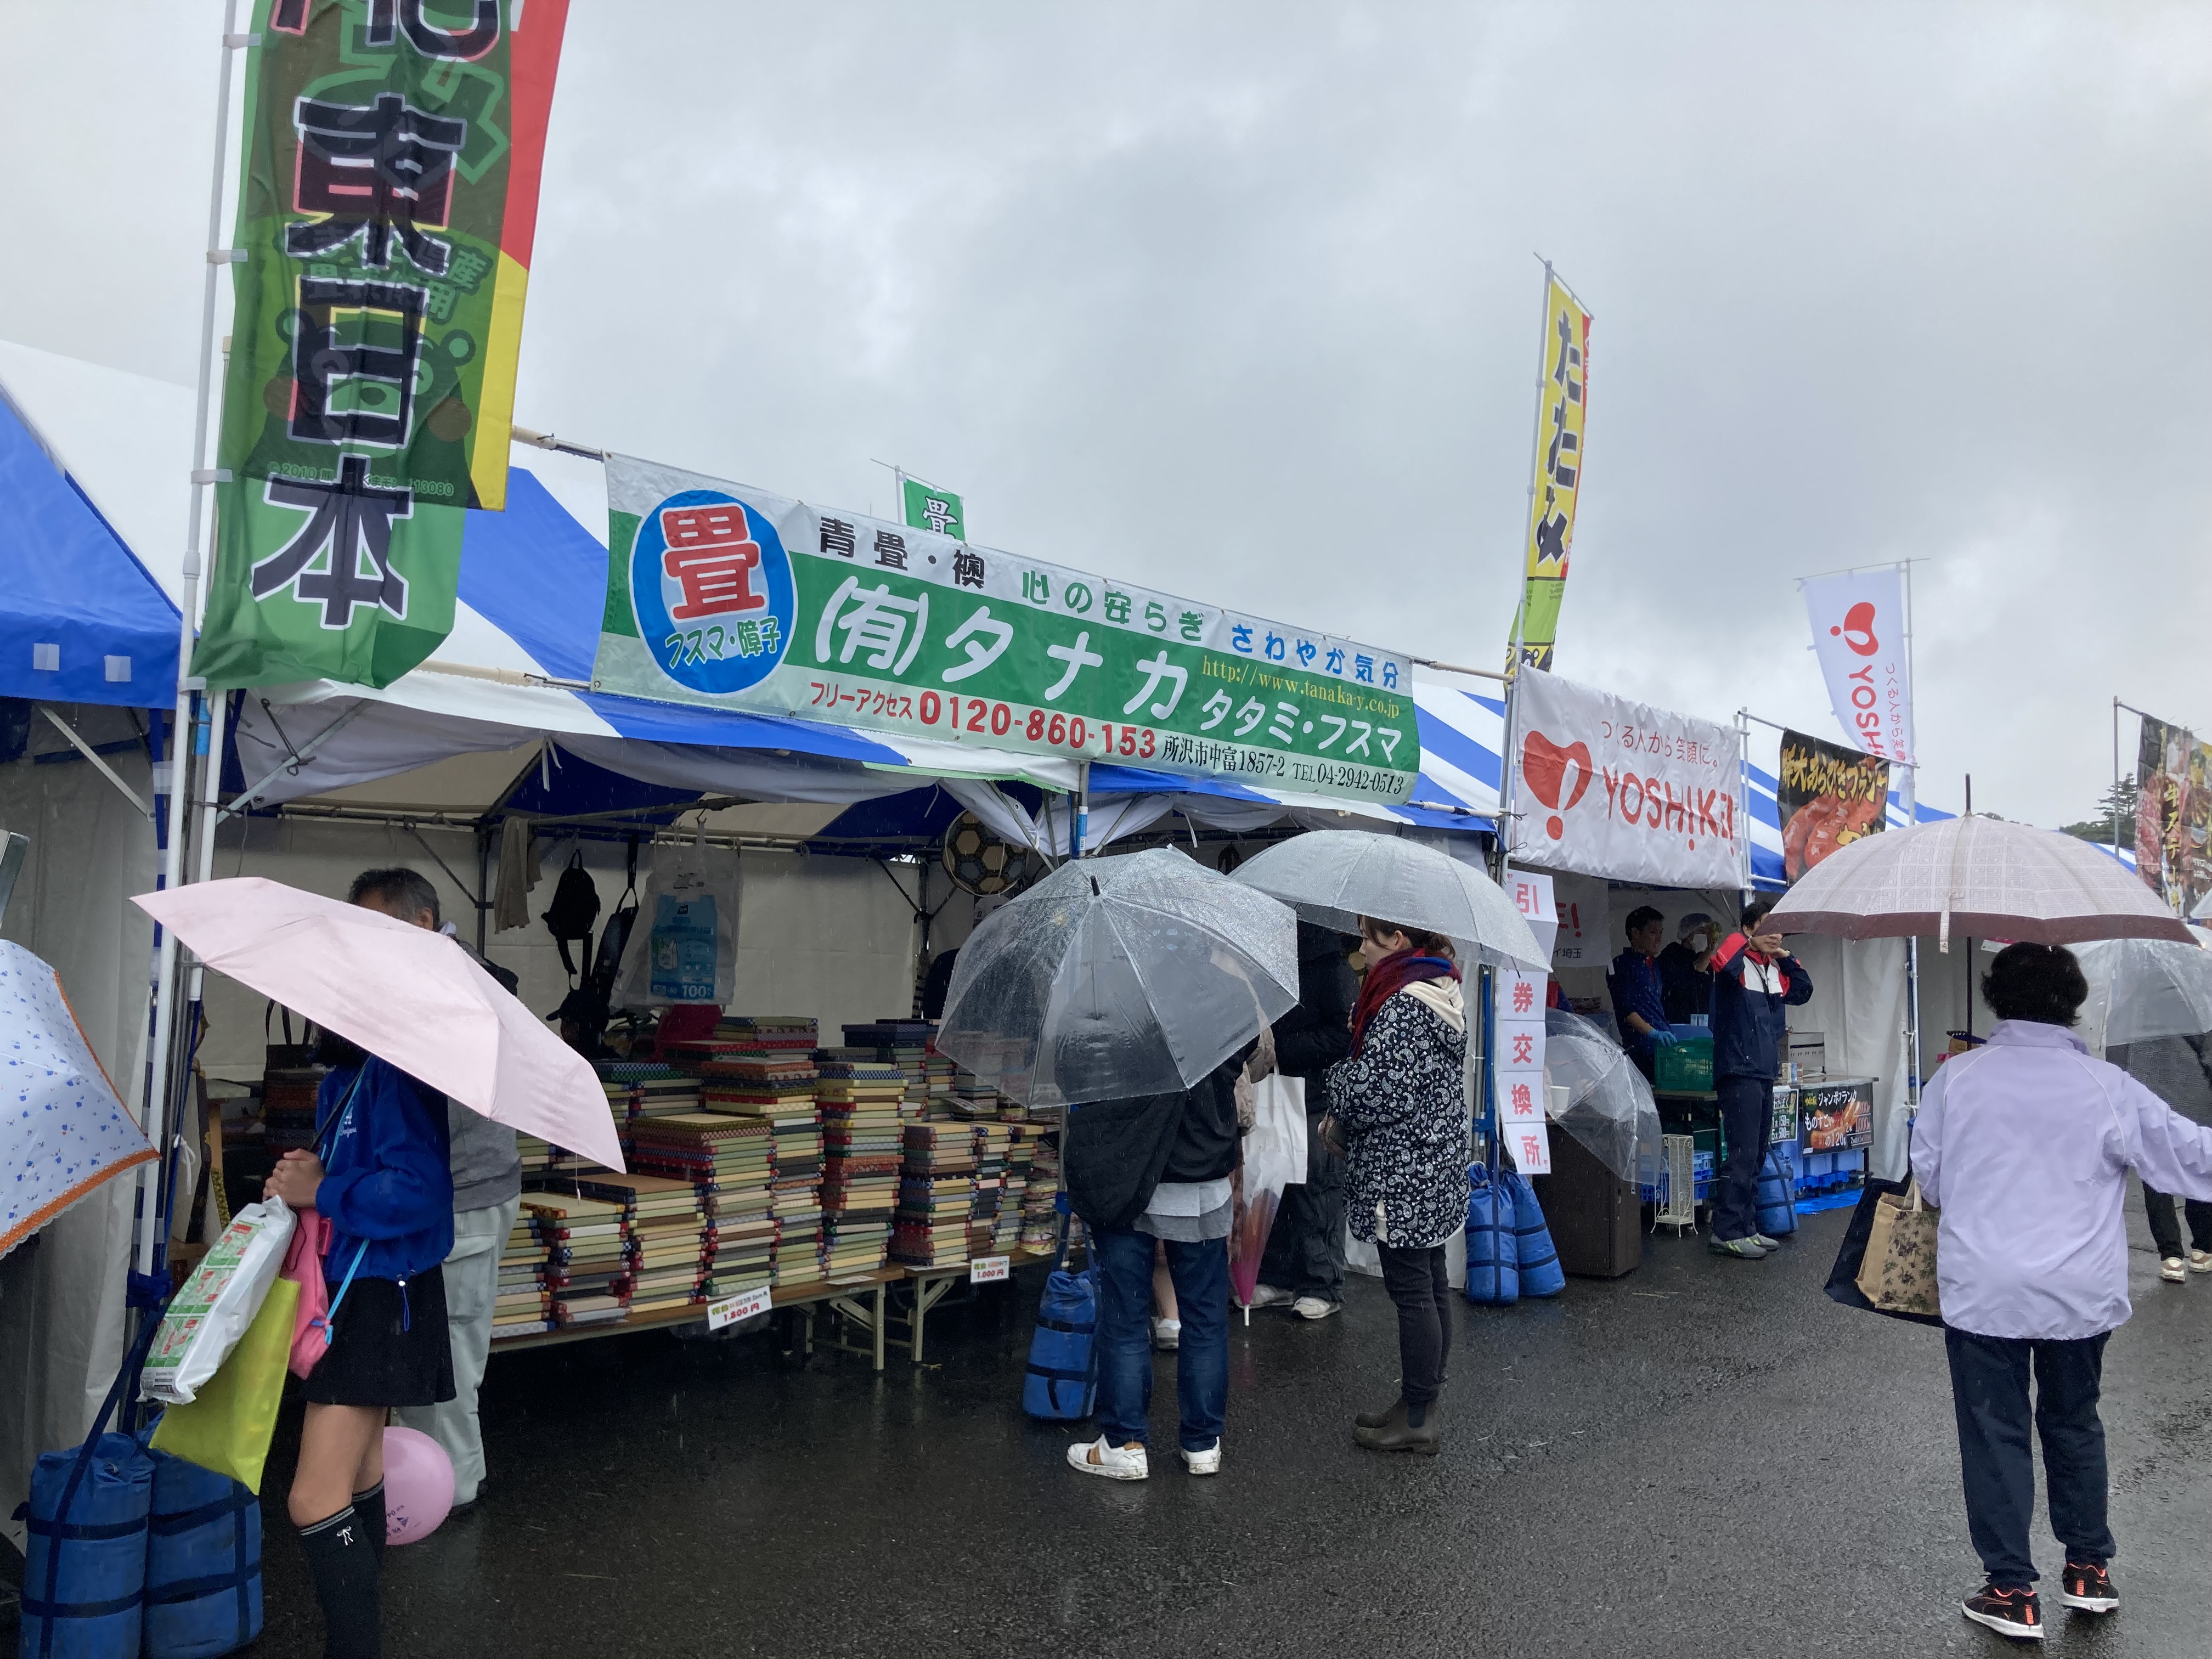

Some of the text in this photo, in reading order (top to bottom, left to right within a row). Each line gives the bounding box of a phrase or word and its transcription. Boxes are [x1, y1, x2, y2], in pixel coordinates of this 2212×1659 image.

[249, 0, 500, 630] 東日本
[922, 495, 958, 540] 畳
[659, 501, 766, 620] 畳
[664, 615, 782, 670] フスマ・障子
[1022, 569, 1205, 642] 心の安らぎ
[1232, 623, 1400, 690] さわやか気分
[1201, 654, 1401, 719] http://www.tanaka-y.co.jp
[811, 682, 913, 720] フリーアクセス
[919, 691, 1156, 759] 0120-860-153
[1161, 735, 1285, 778] 所沢市中富1857-2
[1199, 688, 1402, 763] タタミ・フスマ
[1601, 720, 1718, 768] つくる人から笑顔に。
[1553, 947, 1583, 959] イ埼玉
